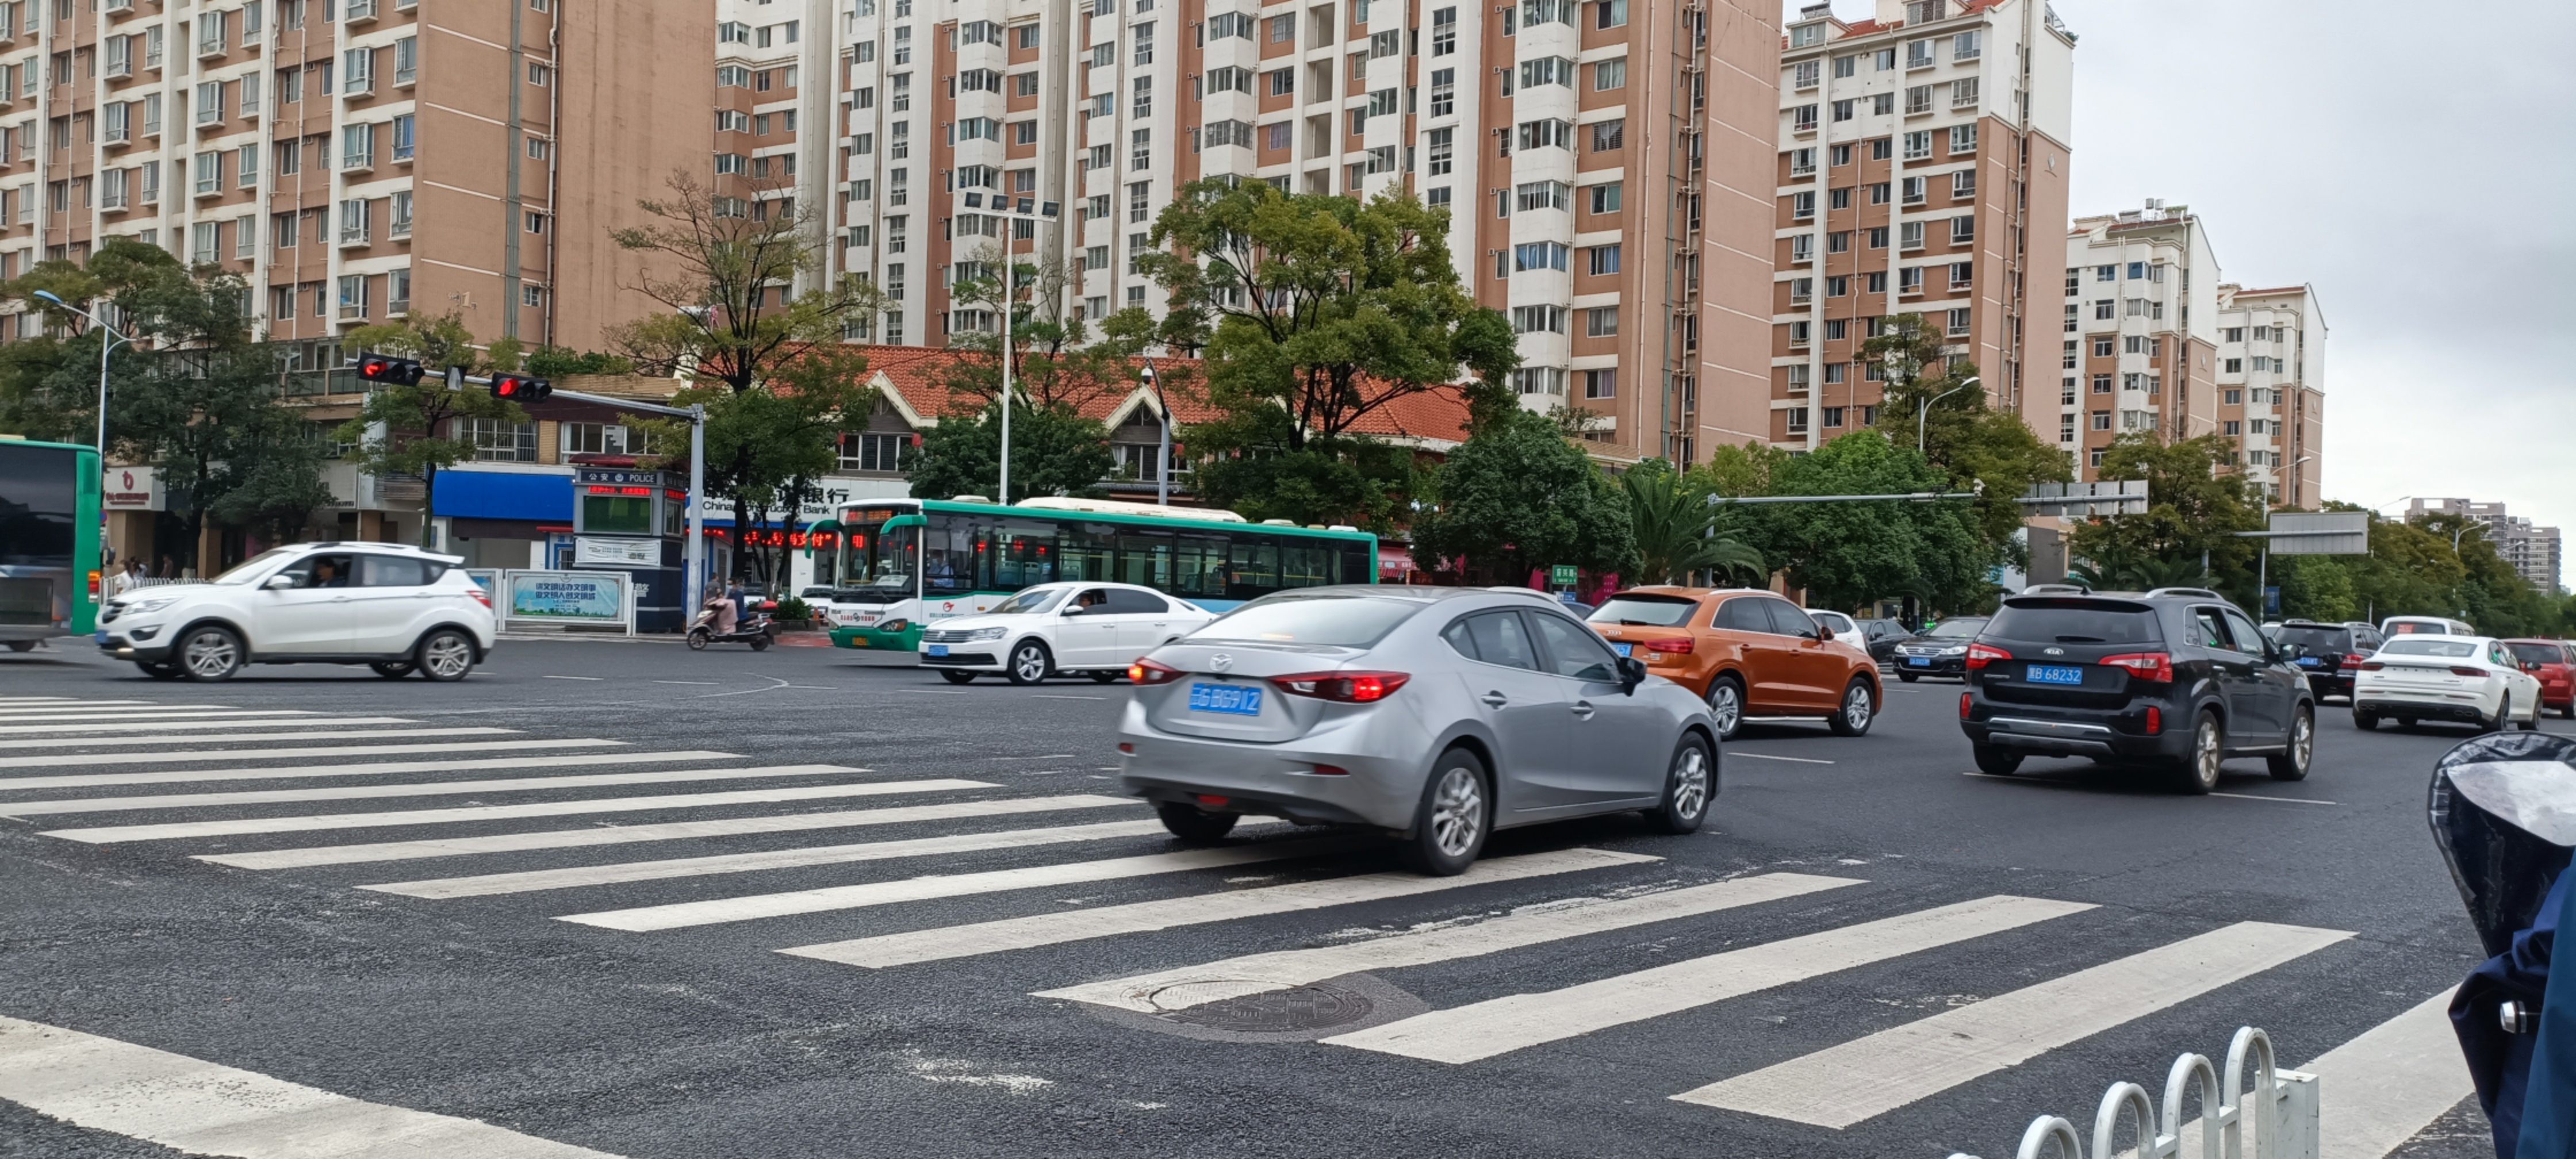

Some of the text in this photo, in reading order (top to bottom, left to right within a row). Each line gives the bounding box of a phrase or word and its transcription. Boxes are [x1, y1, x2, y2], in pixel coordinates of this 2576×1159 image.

[630, 474, 654, 482] POLICE
[703, 501, 734, 511] China
[803, 505, 830, 515] Bank
